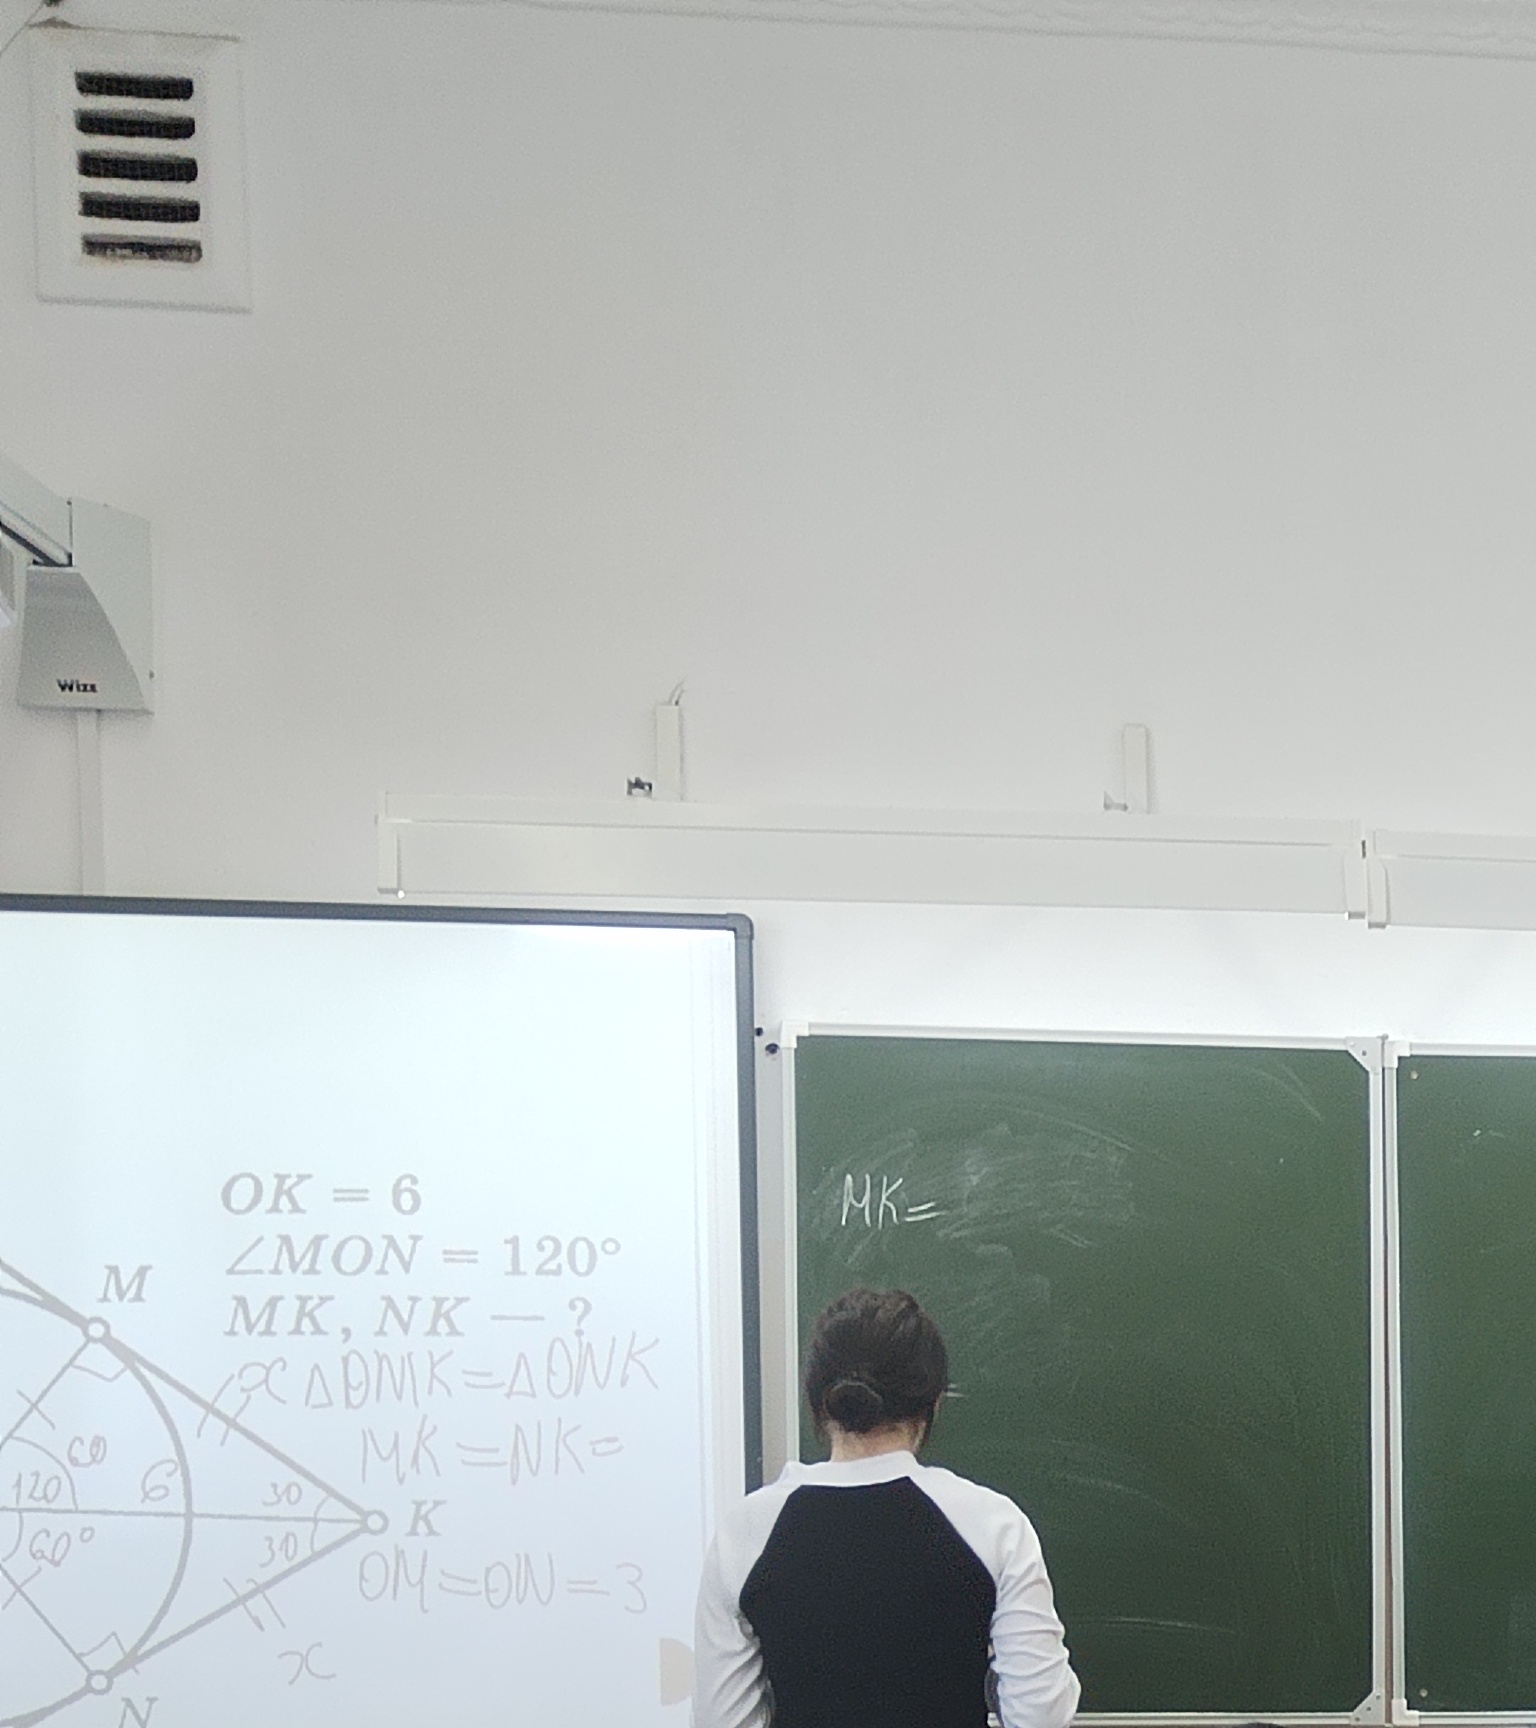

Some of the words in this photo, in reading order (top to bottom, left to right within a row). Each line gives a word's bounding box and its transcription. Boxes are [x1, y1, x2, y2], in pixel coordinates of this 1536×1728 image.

[220, 1172, 313, 1216] OK
[391, 1173, 422, 1216] 6
[99, 1265, 153, 1303] M
[373, 1296, 471, 1338] NK
[262, 1481, 303, 1507] 30
[405, 1500, 449, 1537] K
[259, 1531, 299, 1568] 30
